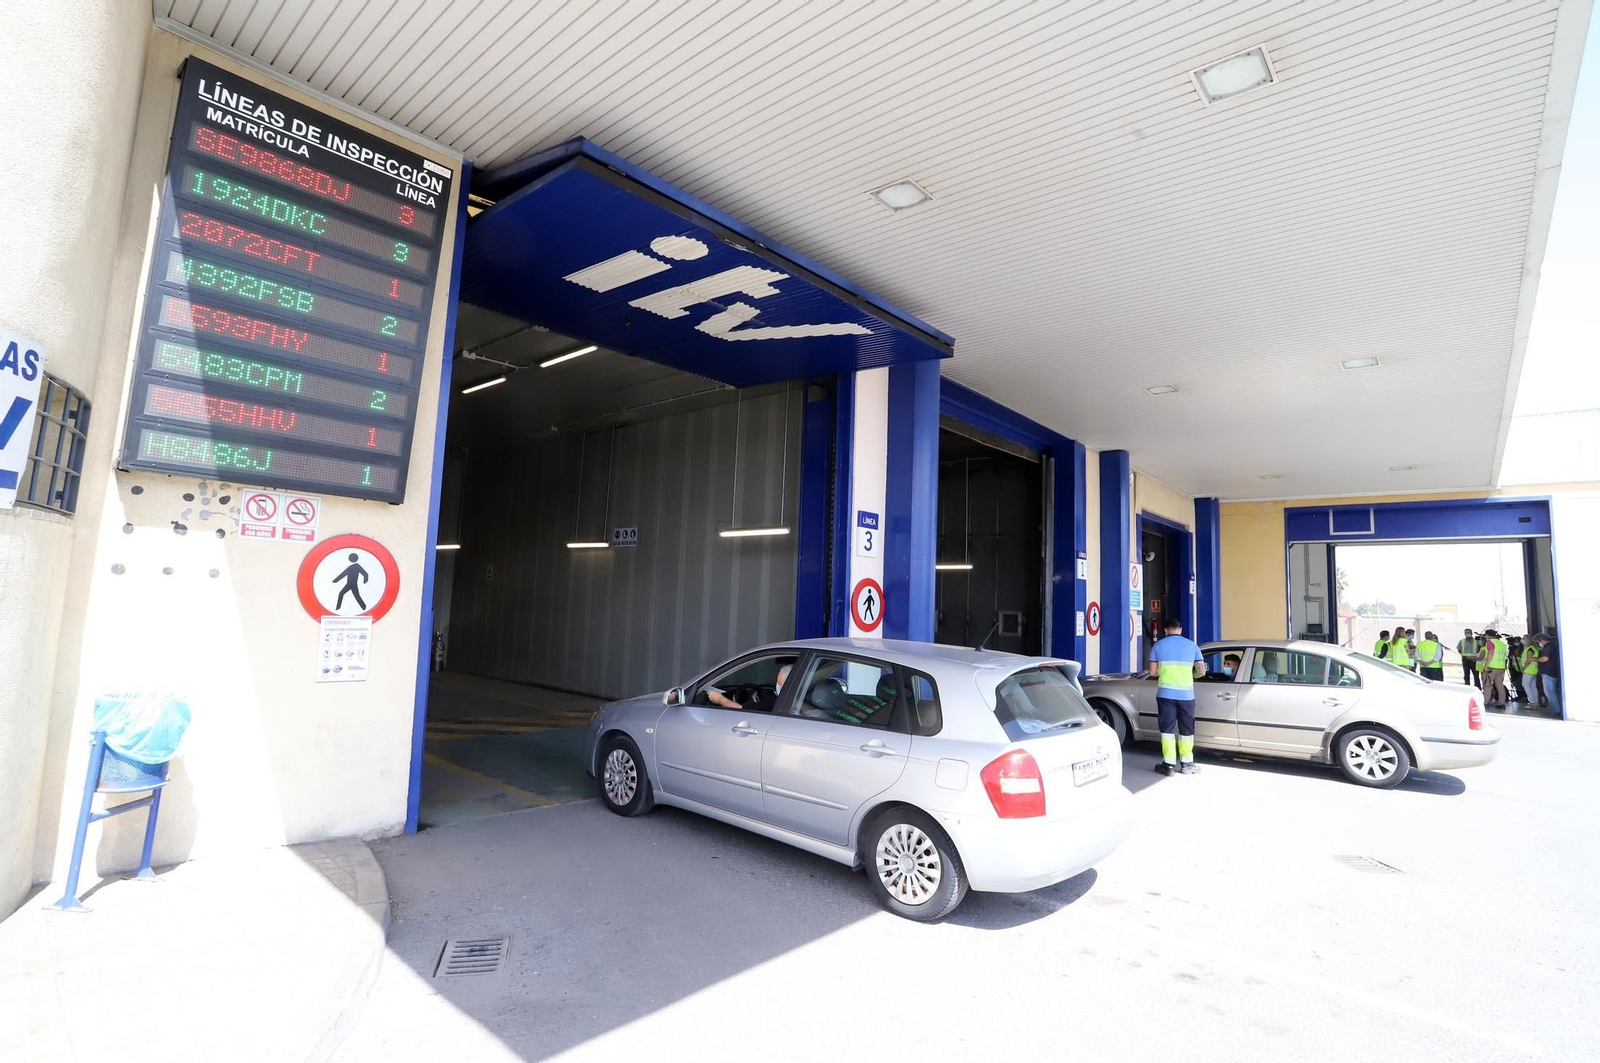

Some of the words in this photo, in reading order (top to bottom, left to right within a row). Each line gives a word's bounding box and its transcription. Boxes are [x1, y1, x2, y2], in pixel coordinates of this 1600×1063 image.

[198, 78, 286, 128] LÍNEAS
[291, 118, 322, 144] DE
[326, 133, 443, 194] INSPECCIÓN
[206, 106, 310, 159] MATRÍCULA
[195, 127, 351, 202] SE9868DJ
[399, 204, 416, 227] 3
[396, 183, 436, 209] LÍNEA
[191, 171, 327, 236] 1924DKC
[393, 241, 410, 264] 3
[180, 212, 322, 273] 2072CFT
[388, 278, 399, 298] 1
[175, 258, 314, 313] 4392FSB
[381, 314, 398, 336] 2
[160, 343, 303, 394] 5483CPM
[370, 389, 386, 411] 2
[377, 352, 388, 373] 1
[366, 427, 377, 448] 1
[361, 465, 372, 486] 1
[863, 530, 873, 552] 3
